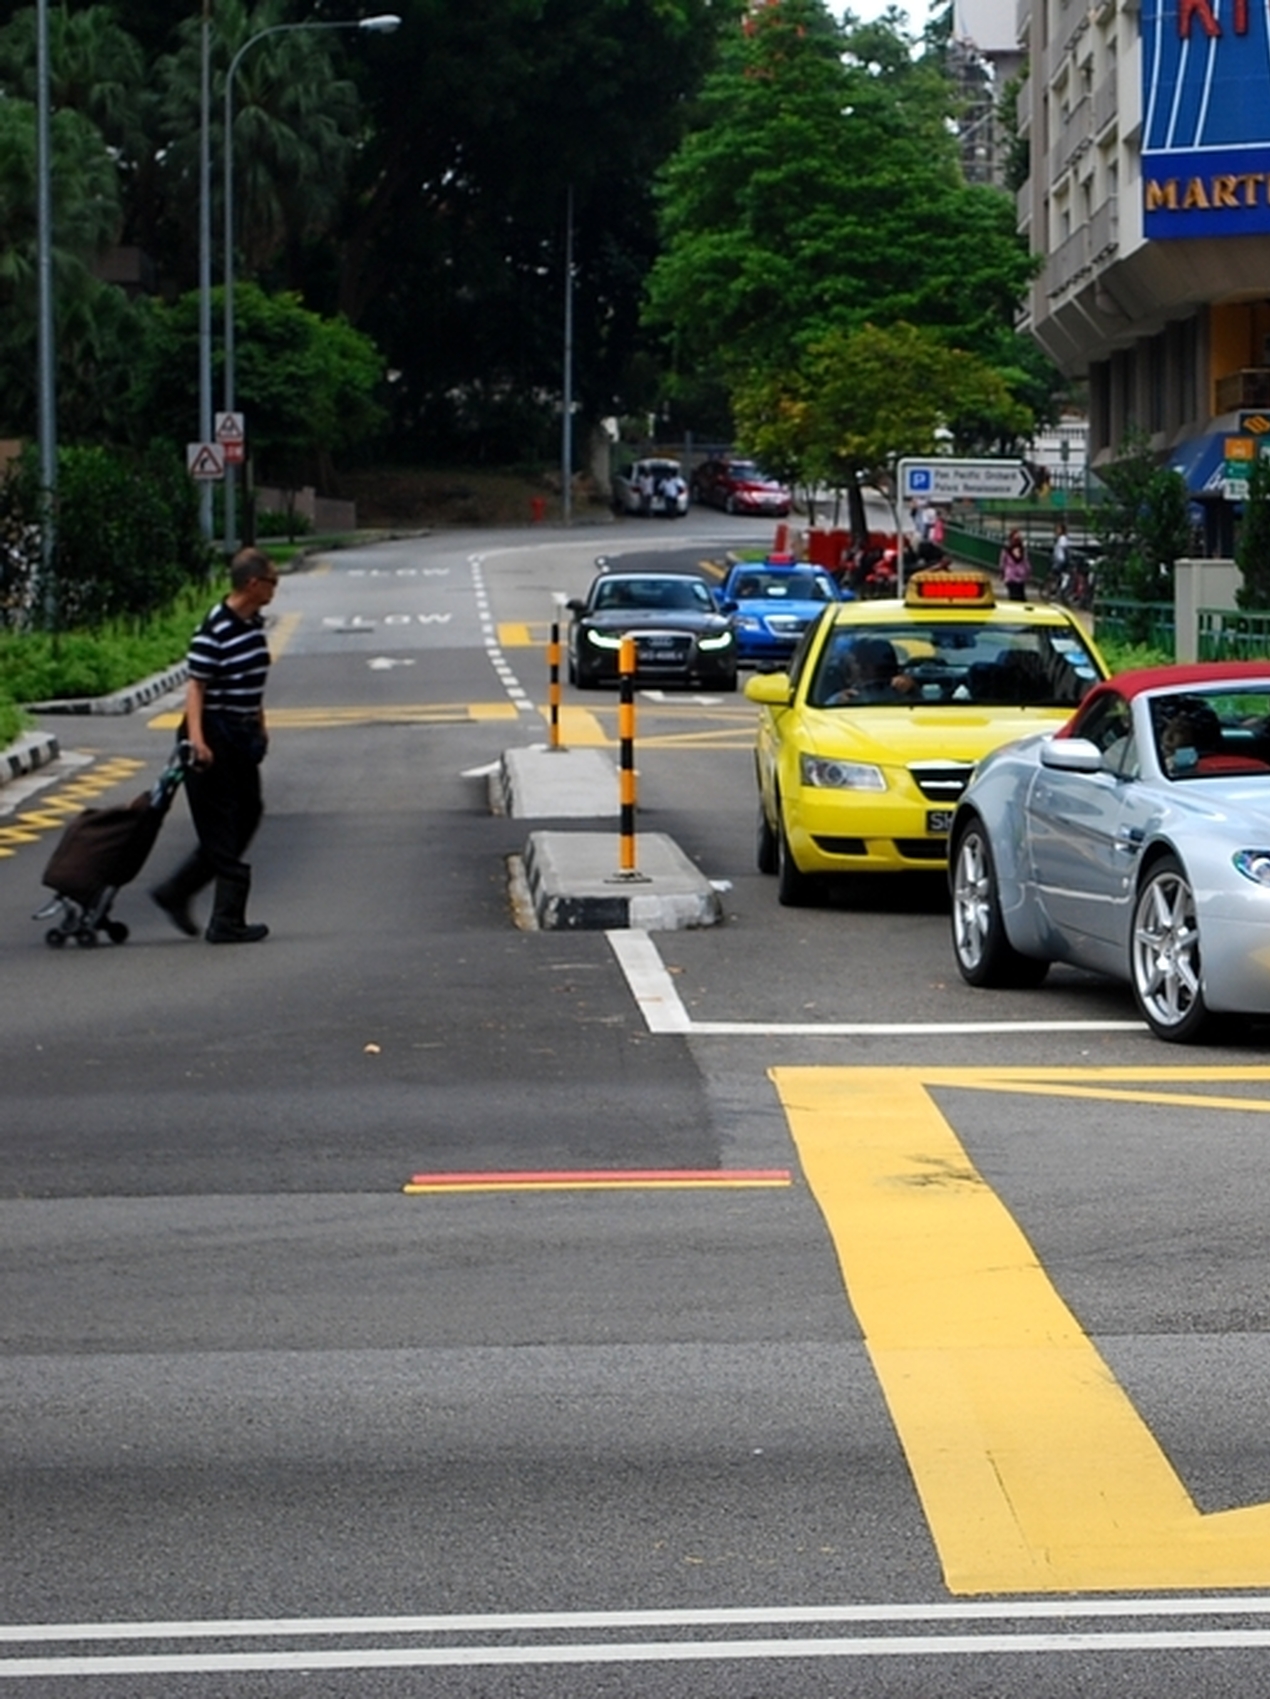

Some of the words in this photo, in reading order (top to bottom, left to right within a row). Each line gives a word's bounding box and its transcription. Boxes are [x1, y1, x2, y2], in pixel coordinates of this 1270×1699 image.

[913, 473, 926, 487] P
[348, 568, 450, 577] SLOW
[322, 612, 452, 628] SLOW
